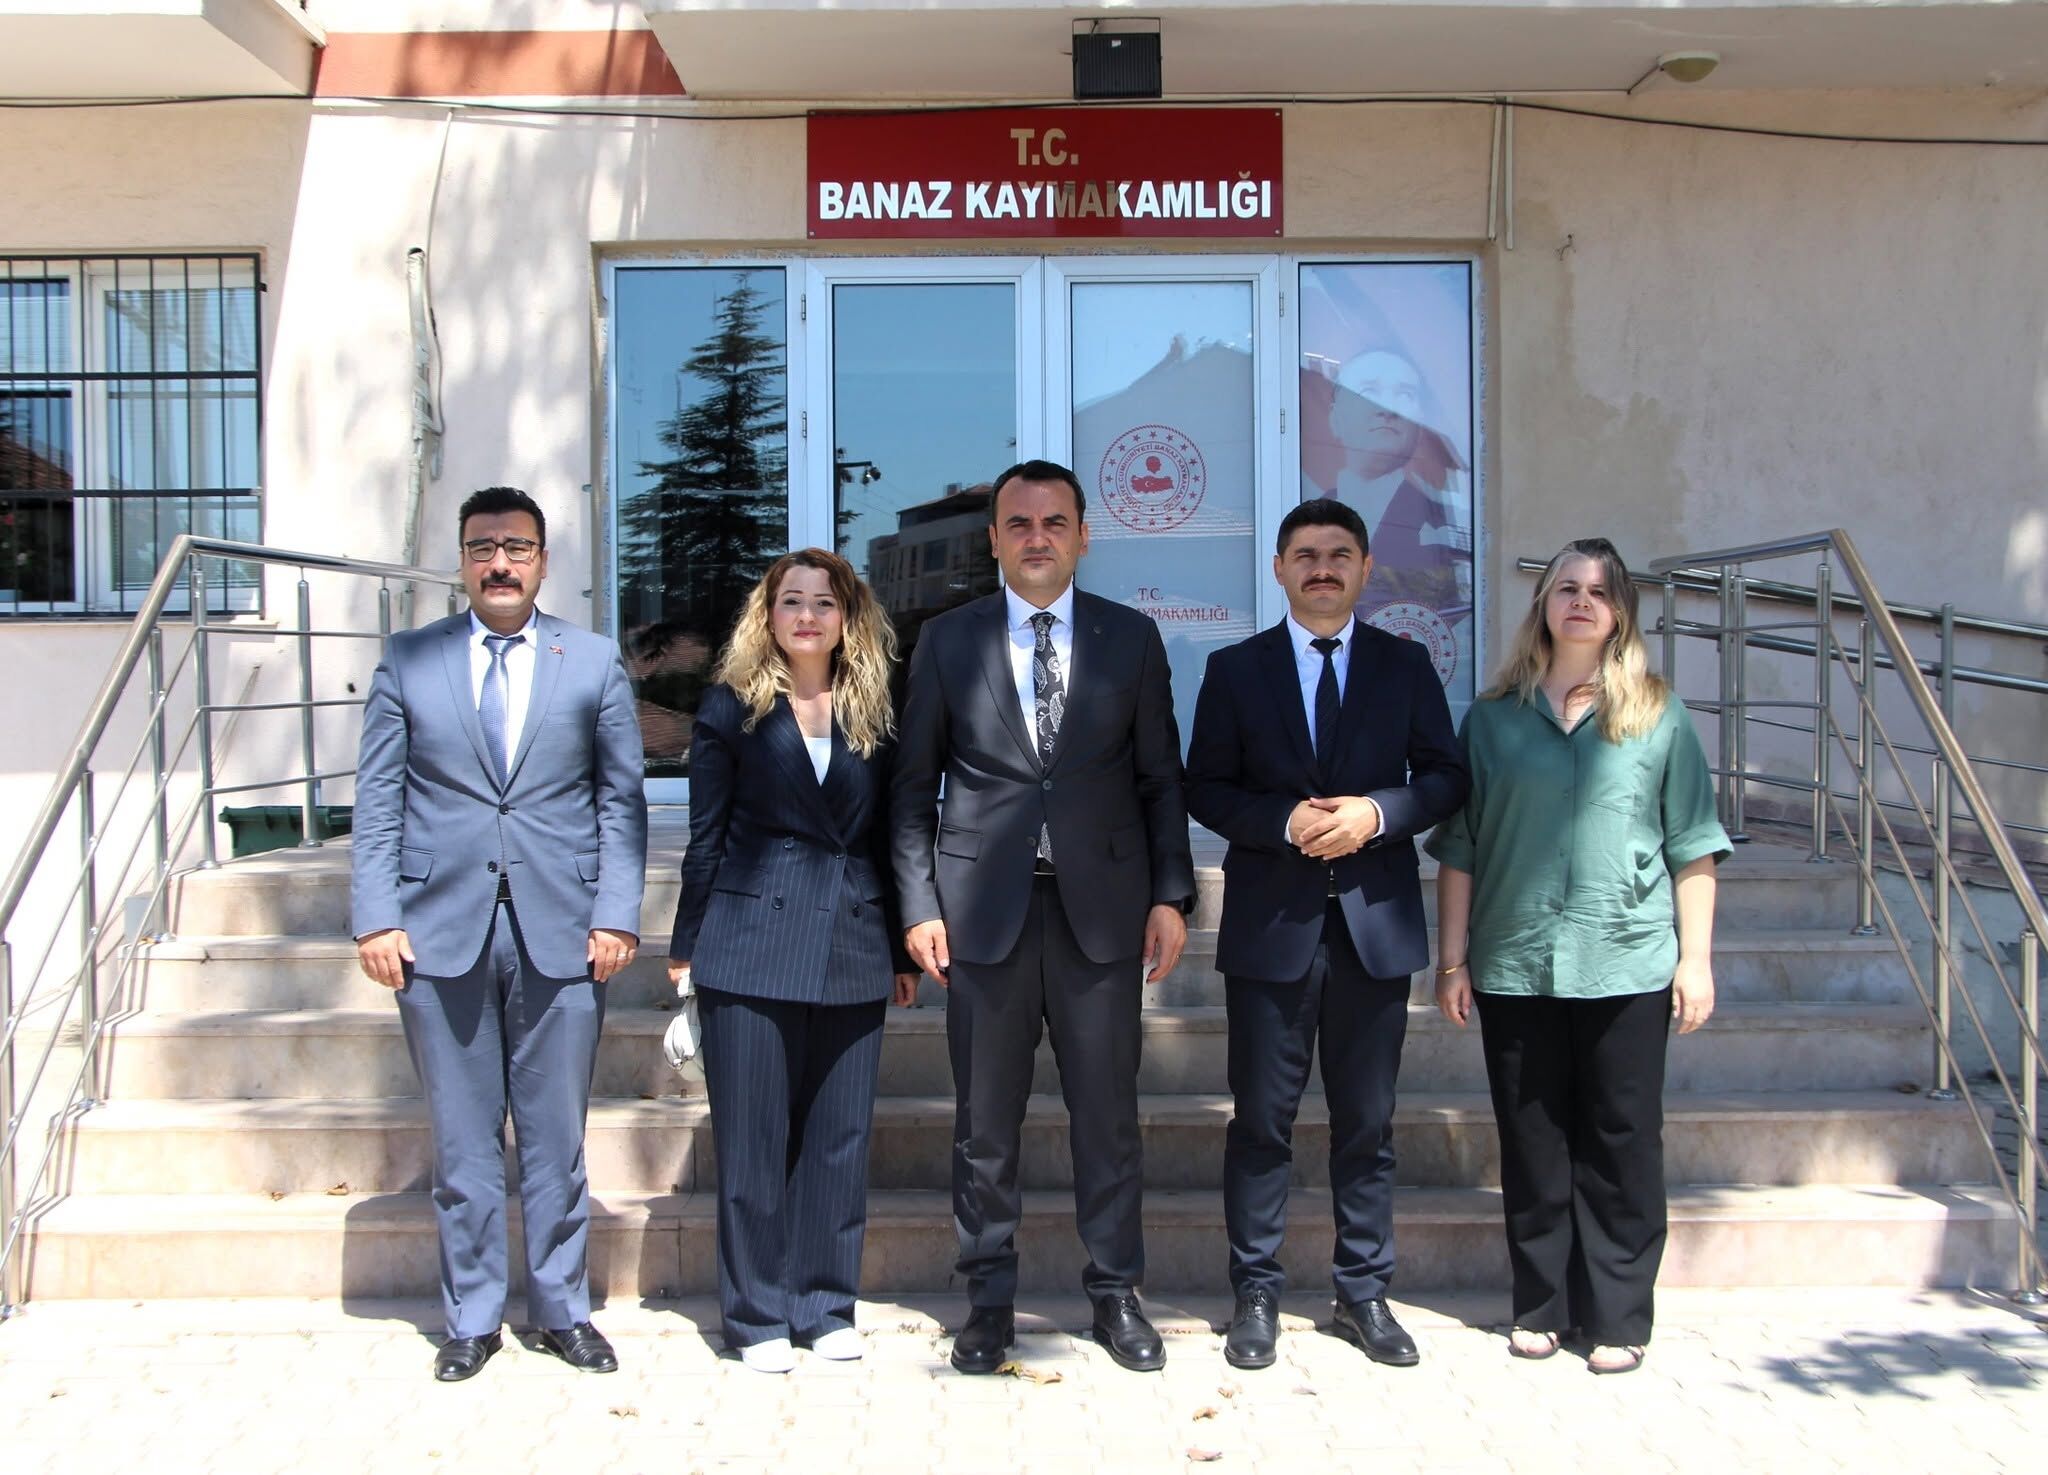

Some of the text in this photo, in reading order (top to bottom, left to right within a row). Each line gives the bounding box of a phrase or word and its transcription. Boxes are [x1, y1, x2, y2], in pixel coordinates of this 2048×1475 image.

[1010, 127, 1079, 166] T.C.
[819, 170, 1271, 220] BANAZ KAYMAKAMLIĞI
[1138, 587, 1164, 601] T.C.
[1137, 604, 1229, 621] YMAKAMLIĞI
